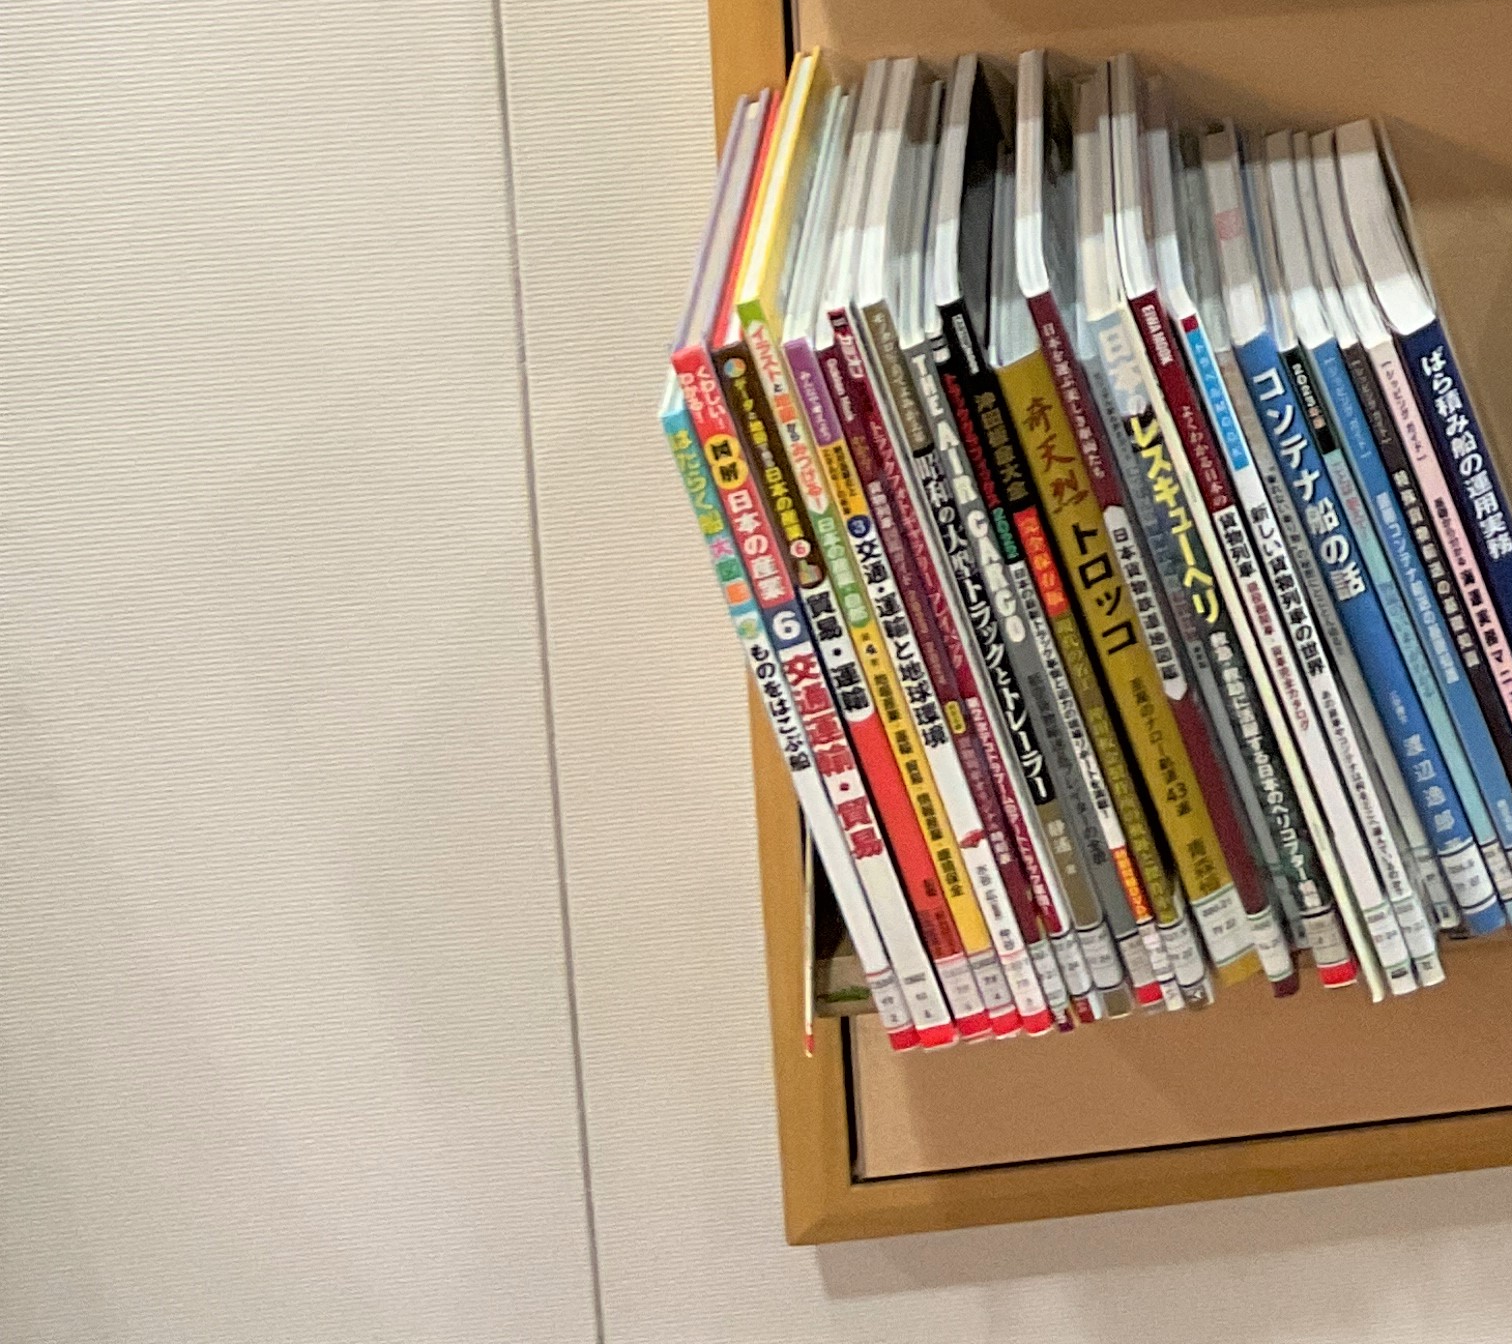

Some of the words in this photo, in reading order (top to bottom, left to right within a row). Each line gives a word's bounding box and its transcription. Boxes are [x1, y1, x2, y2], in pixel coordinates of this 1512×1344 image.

[727, 488, 788, 601] 日本の産業
[911, 353, 944, 416] THE
[936, 421, 978, 504] AIR
[966, 509, 1036, 643] CARGO
[1022, 395, 1139, 656] 奇天烈トロッコ
[1129, 416, 1220, 624] レスキューヘリ
[1252, 365, 1368, 603] コンテナ船の話
[1420, 343, 1512, 562] ばら積み船の運用実務
[772, 611, 800, 640] 6
